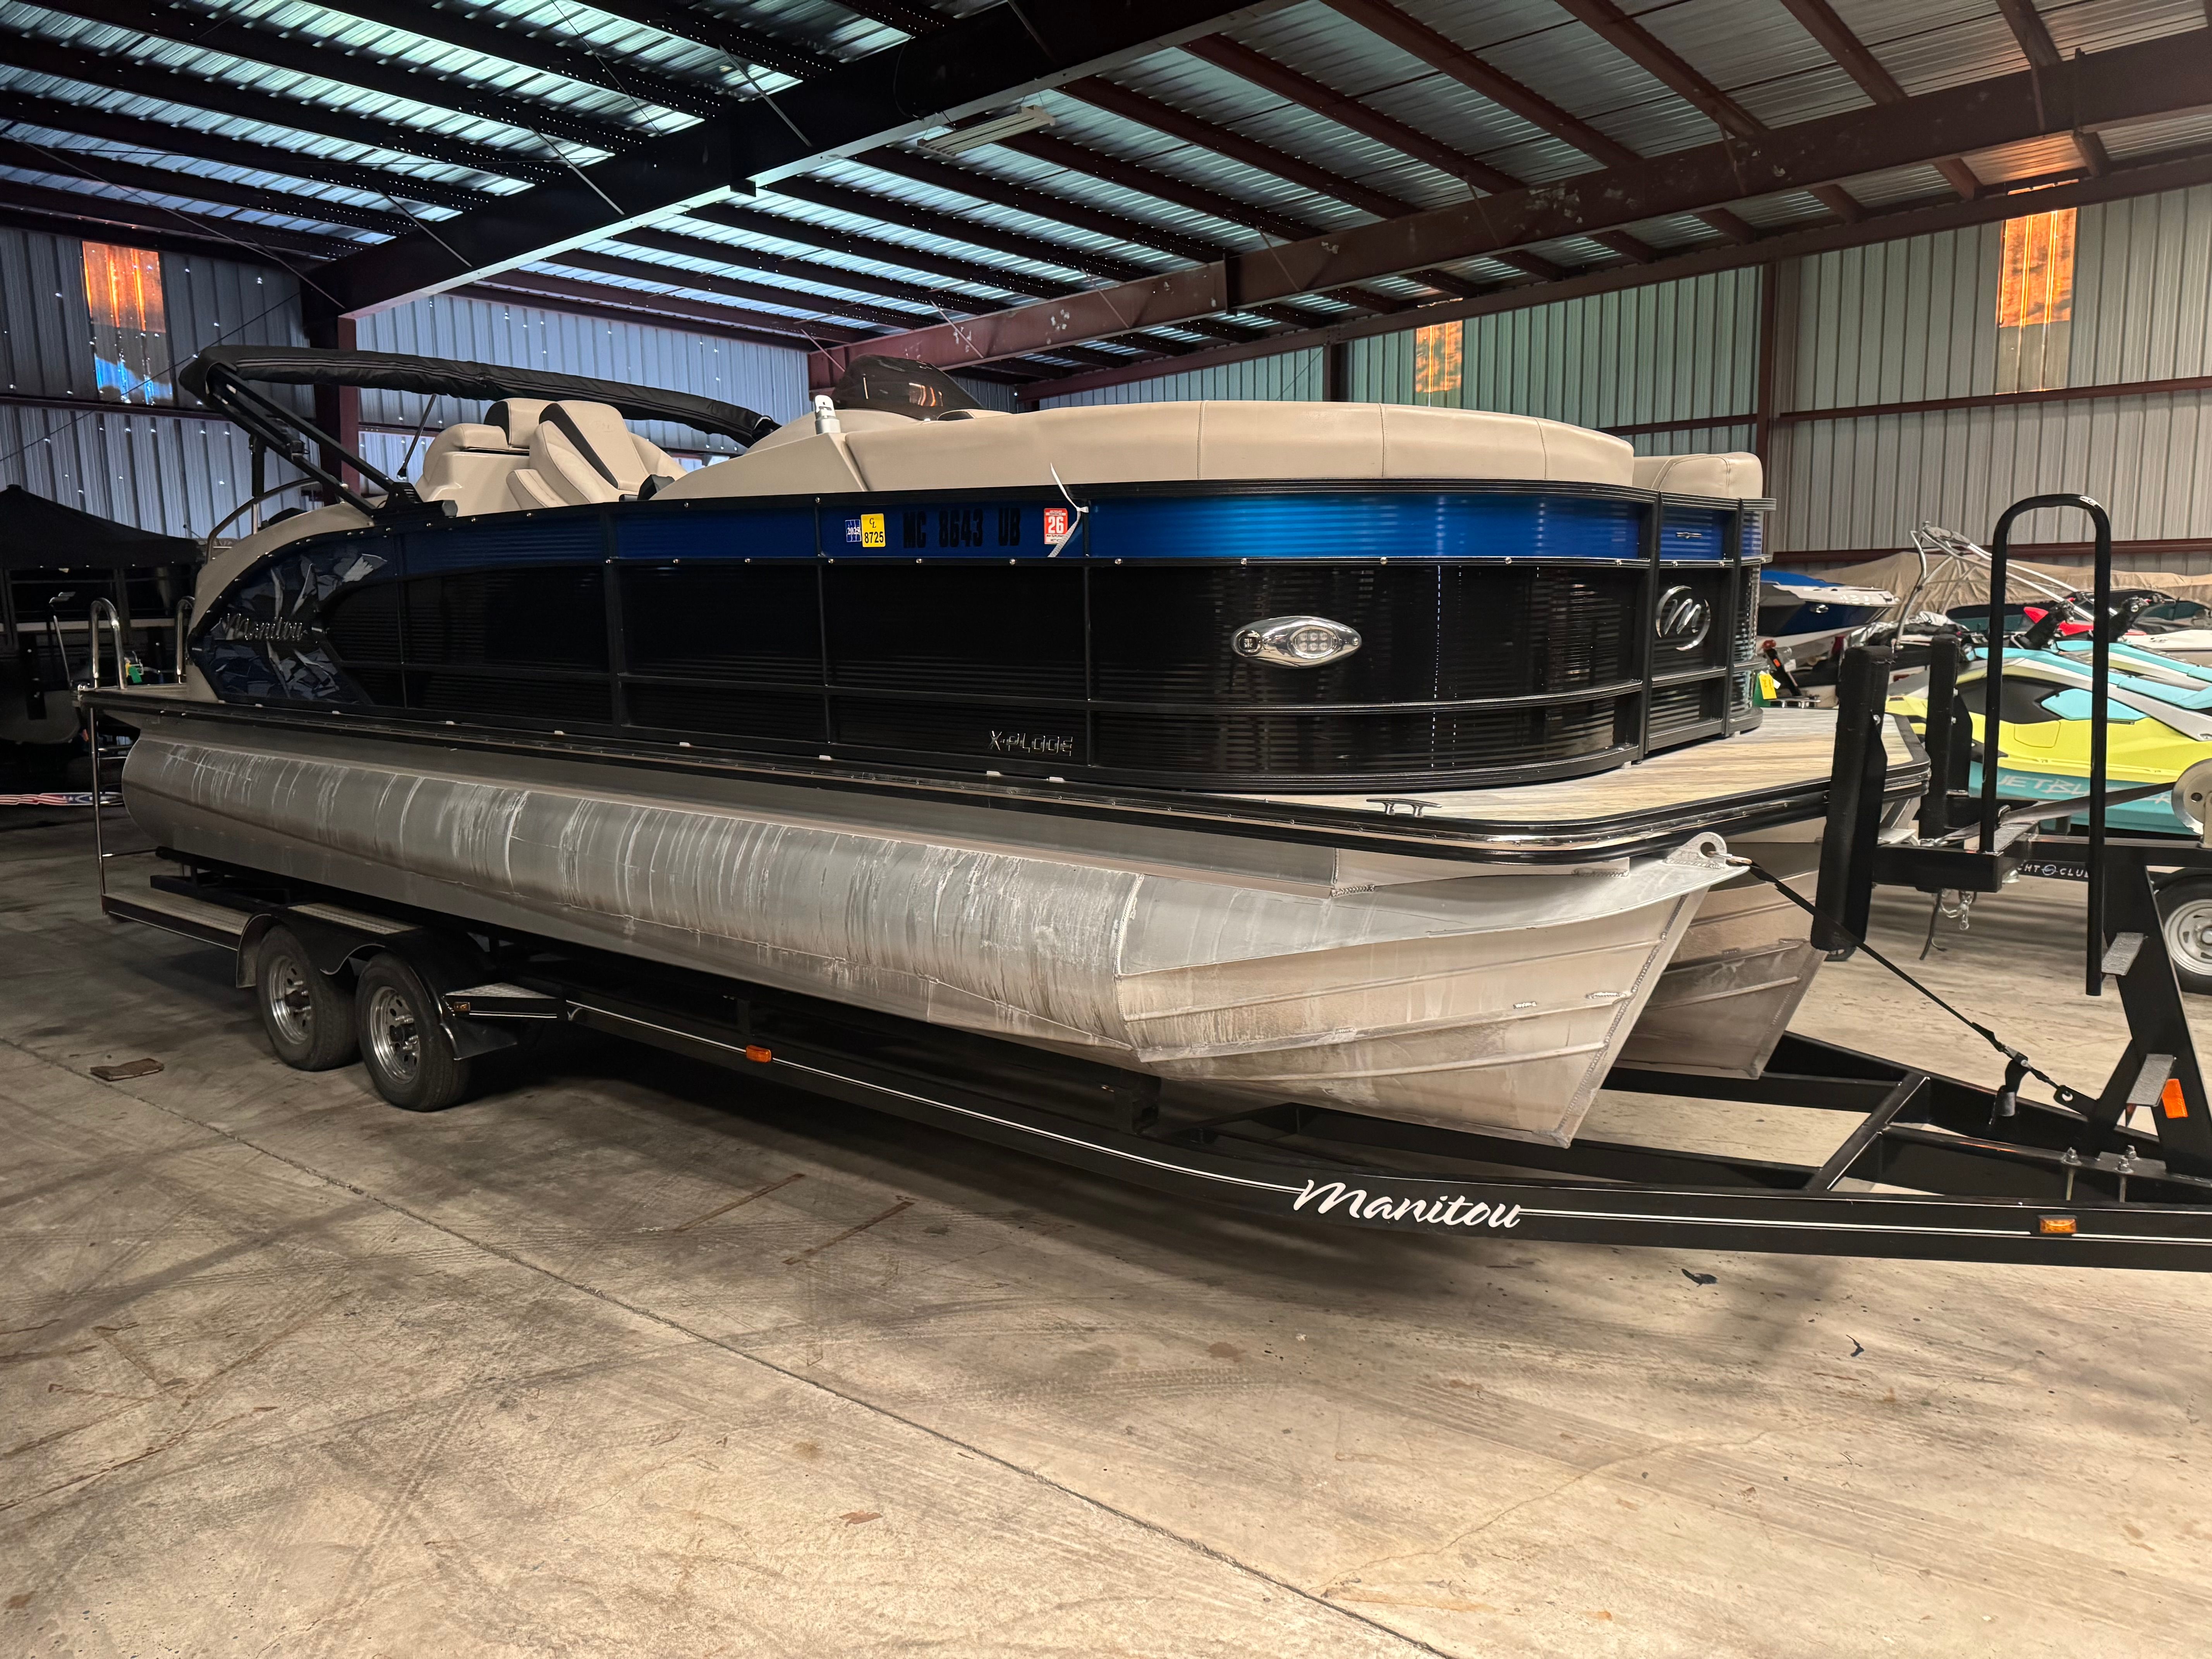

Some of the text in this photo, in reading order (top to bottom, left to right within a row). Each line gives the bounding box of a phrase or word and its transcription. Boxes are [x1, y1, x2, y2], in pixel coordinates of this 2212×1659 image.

[864, 531, 884, 544] 8725
[998, 507, 1021, 546] UB
[1048, 516, 1064, 534] 26
[1293, 1179, 1521, 1228] Manitou
